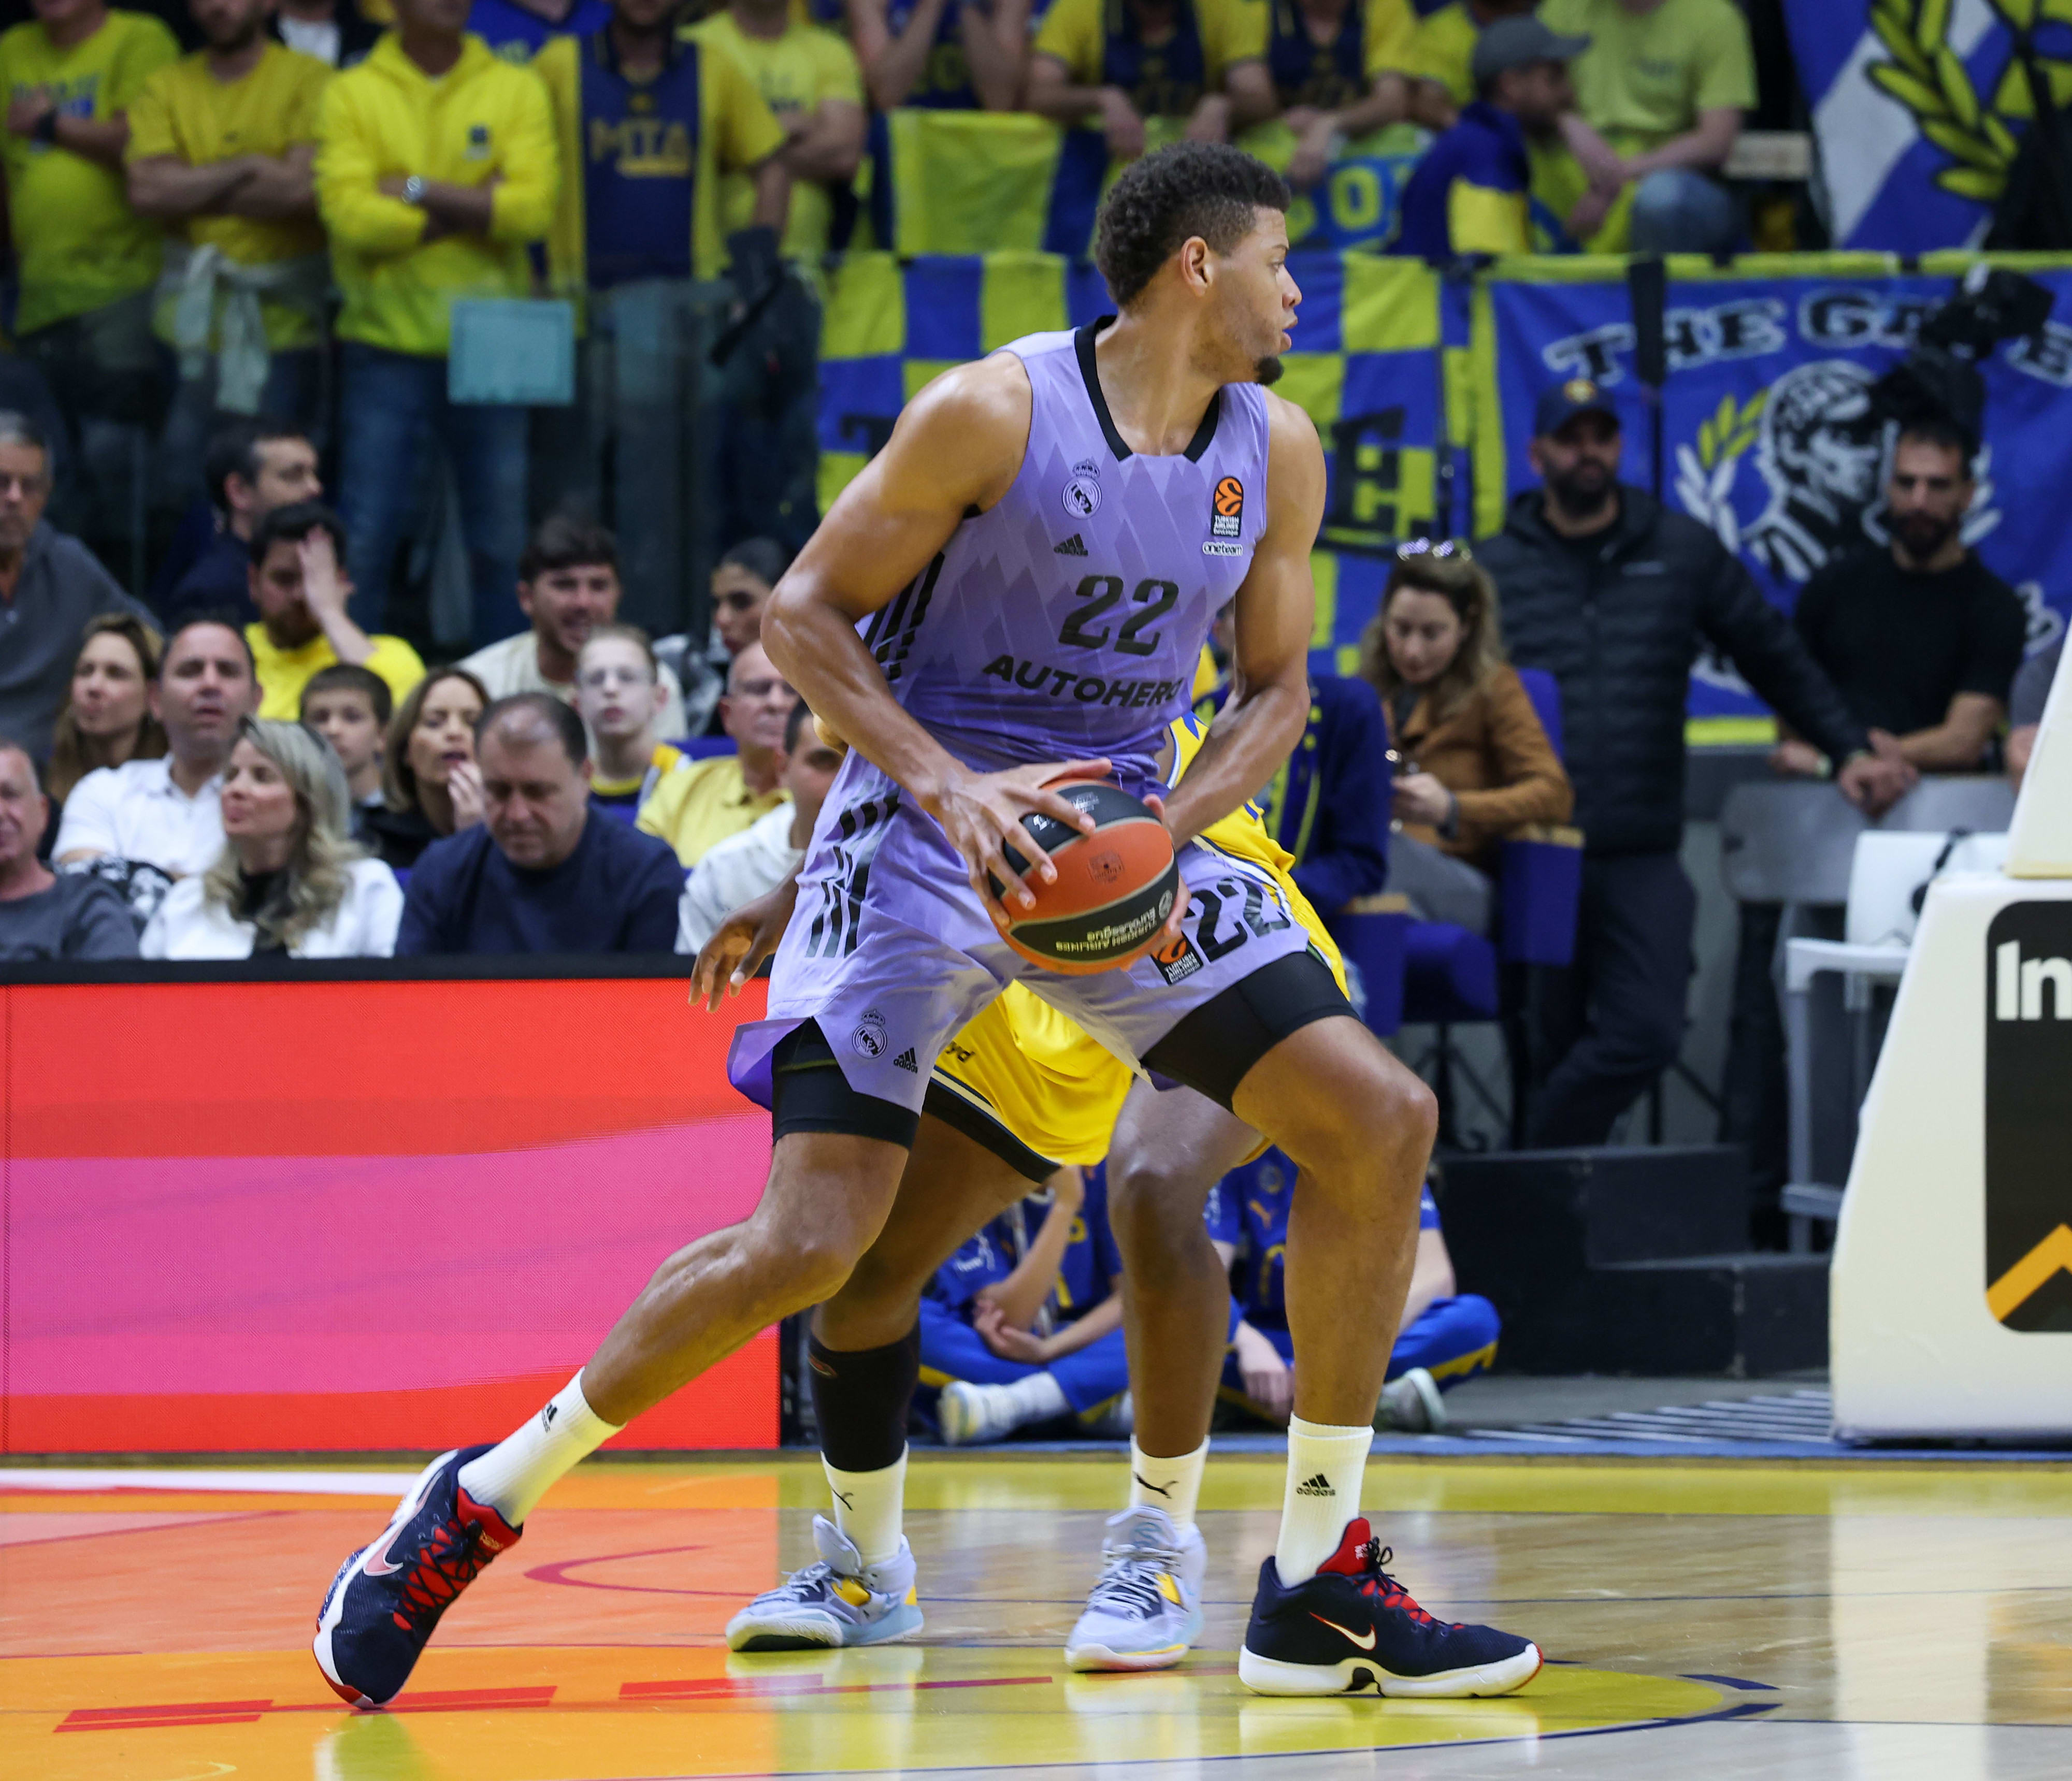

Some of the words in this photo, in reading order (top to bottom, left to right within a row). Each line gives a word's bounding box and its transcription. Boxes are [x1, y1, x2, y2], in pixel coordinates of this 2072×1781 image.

[1058, 574, 1179, 657] 22
[982, 654, 1185, 707] AUTOHERO
[1183, 875, 1291, 964] 22
[893, 1058, 918, 1074] adidas
[1297, 1486, 1335, 1496] adidas
